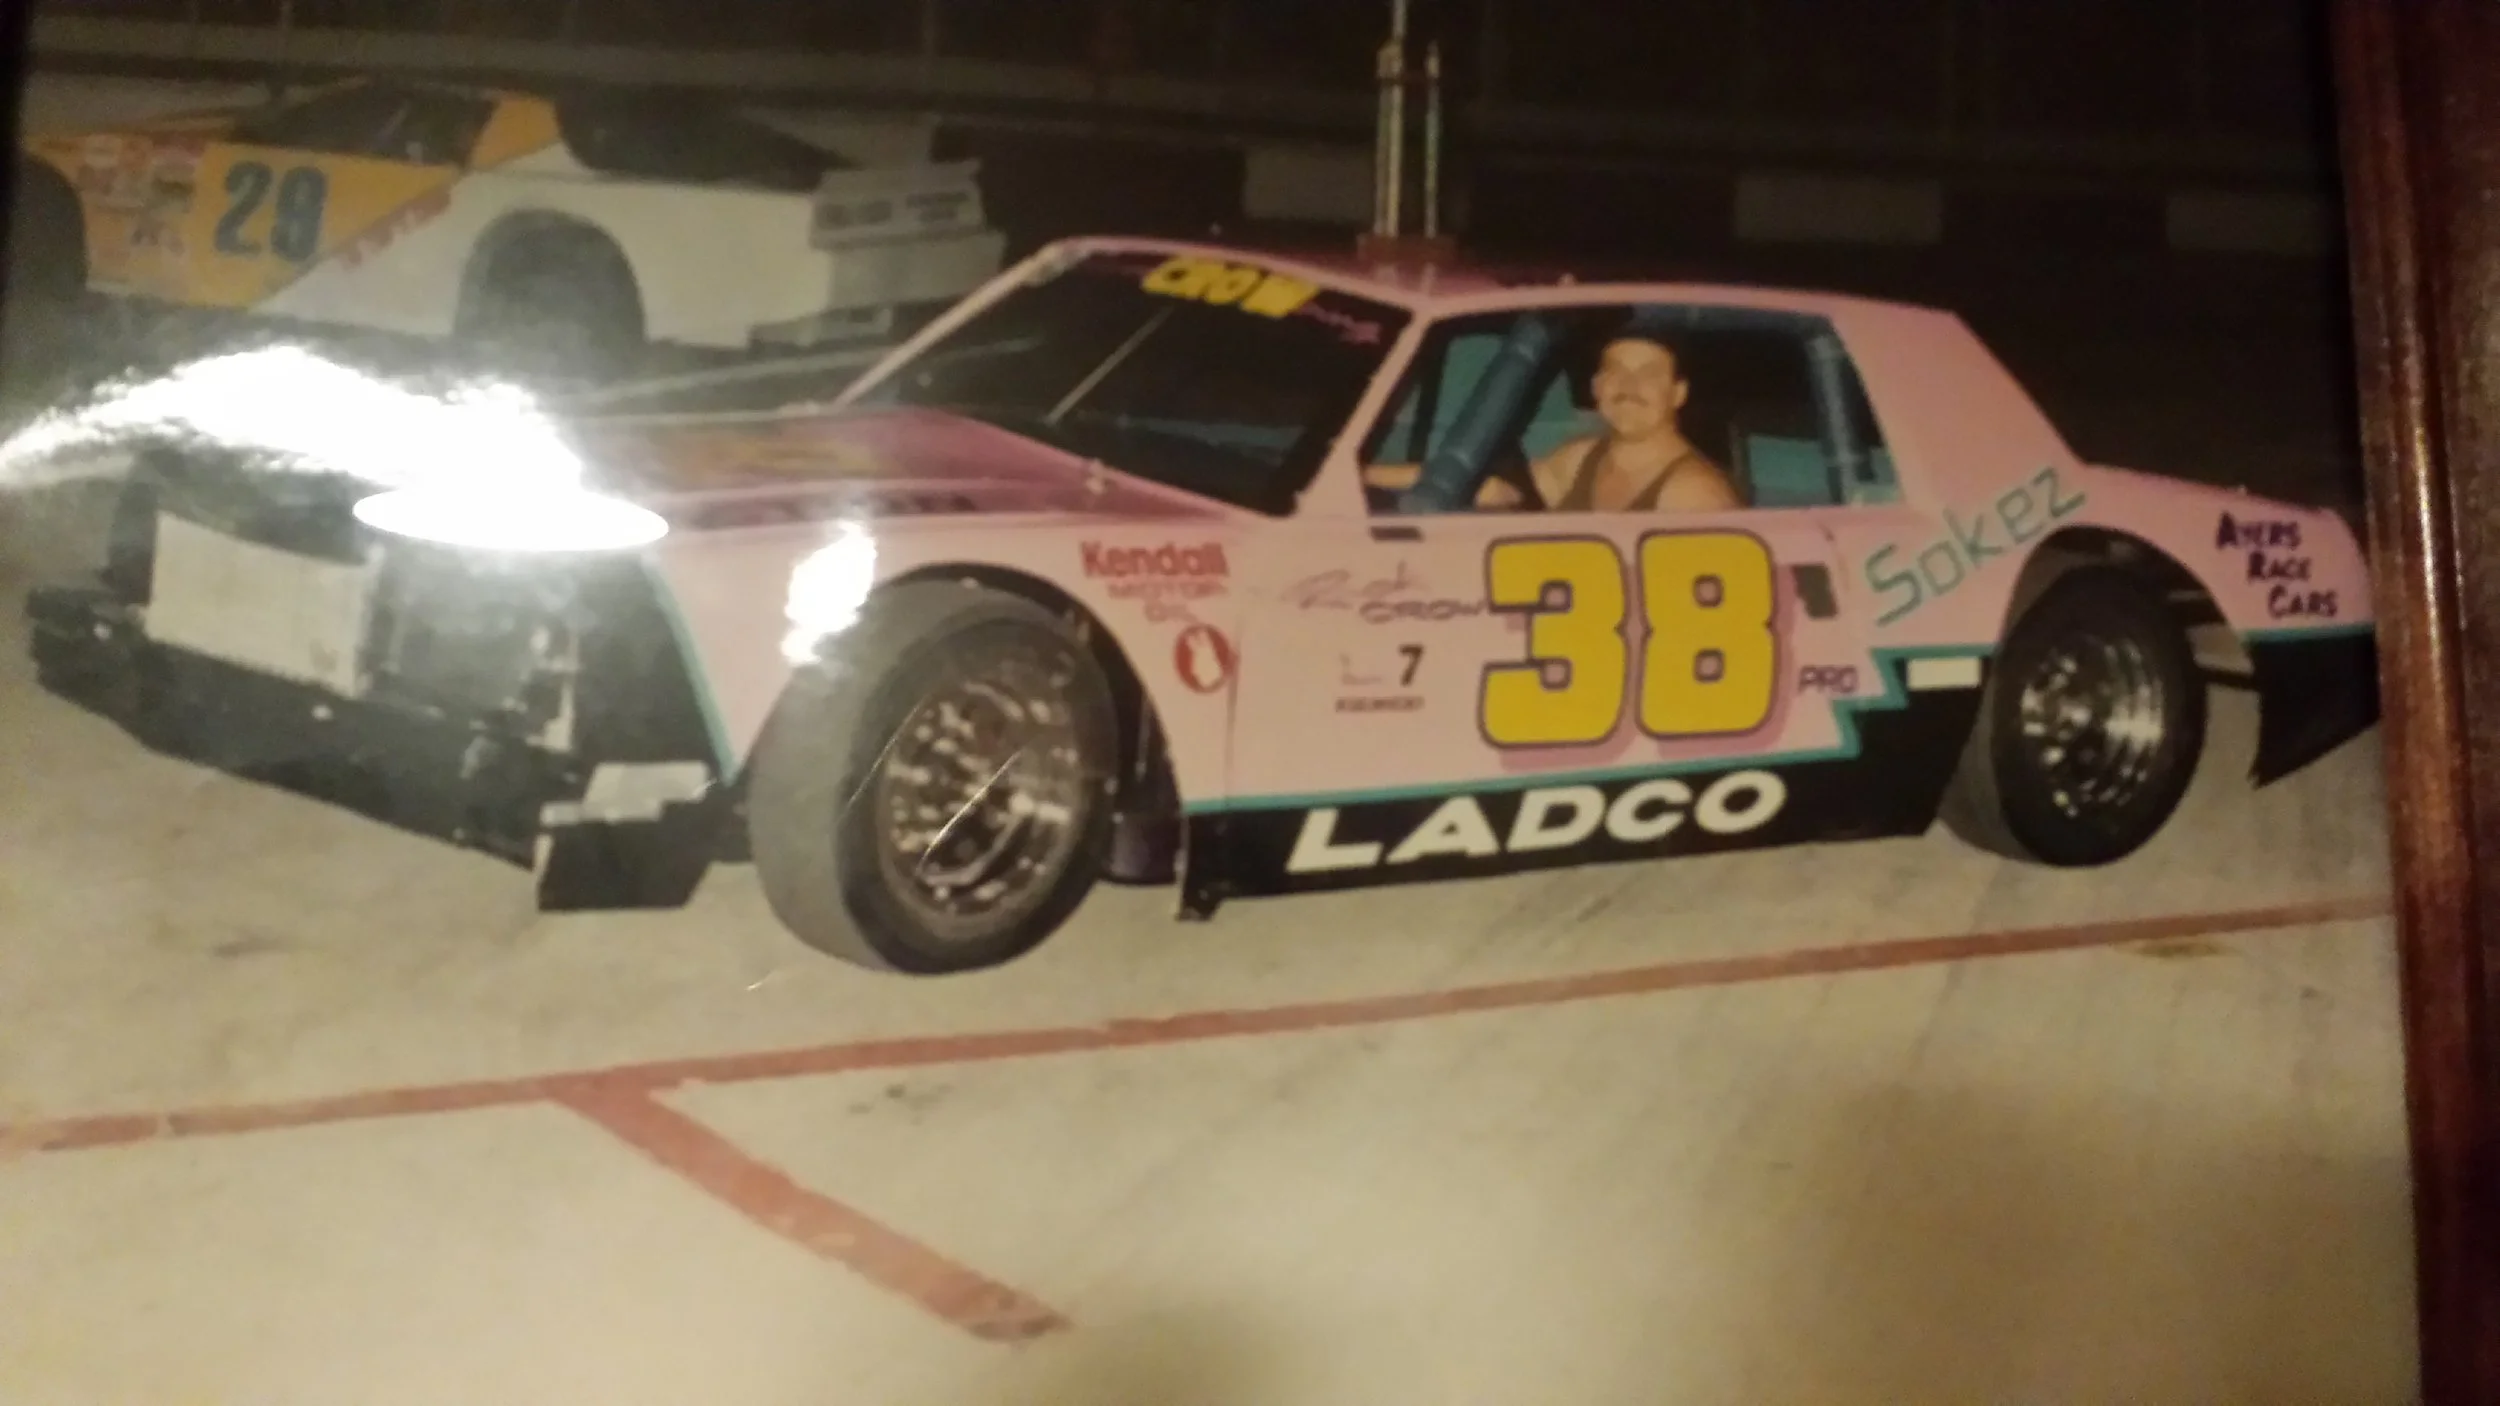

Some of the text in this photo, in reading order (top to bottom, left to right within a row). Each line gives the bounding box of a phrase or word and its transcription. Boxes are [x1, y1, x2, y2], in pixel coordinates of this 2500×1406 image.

[1140, 254, 1321, 320] CROW
[1866, 466, 2087, 626] Sokez
[1398, 643, 1425, 687] 7
[1477, 528, 1776, 749] 38
[1800, 666, 1859, 693] PRO
[1286, 770, 1787, 872] LADCO
